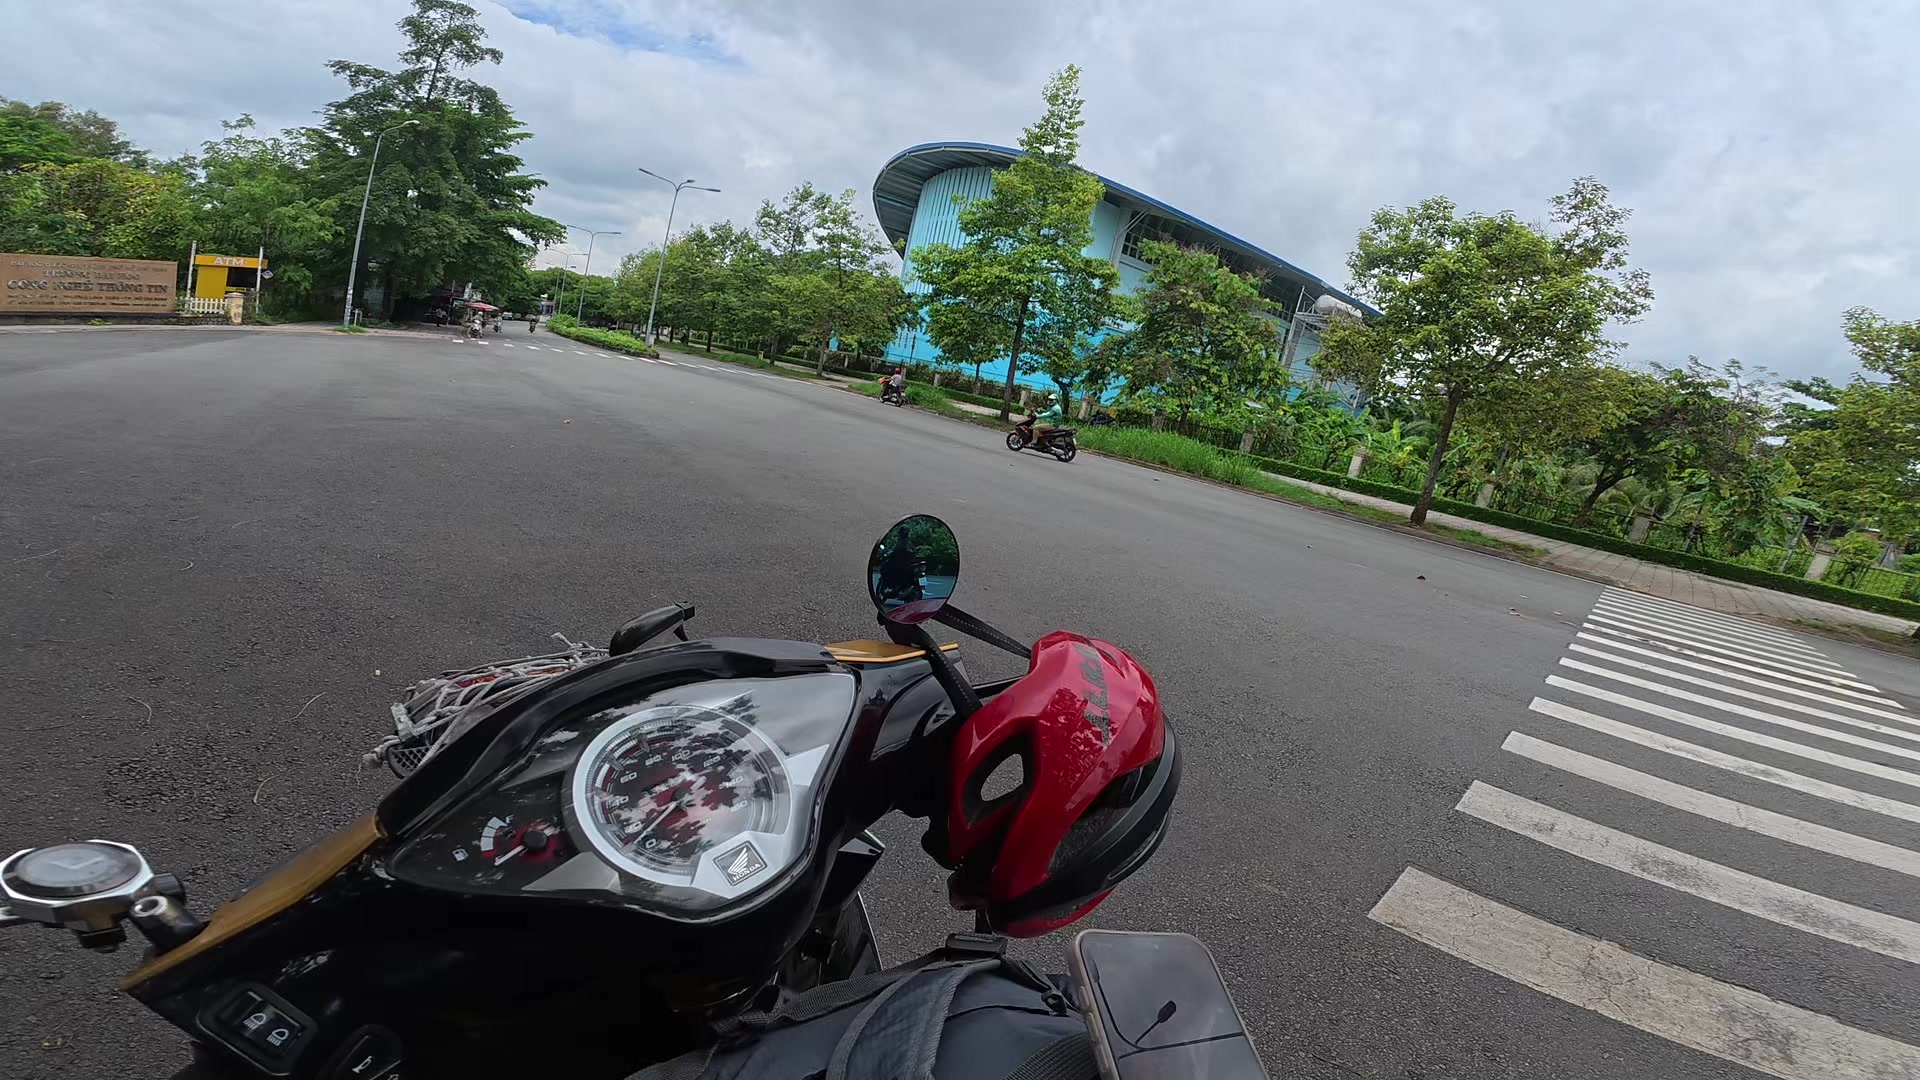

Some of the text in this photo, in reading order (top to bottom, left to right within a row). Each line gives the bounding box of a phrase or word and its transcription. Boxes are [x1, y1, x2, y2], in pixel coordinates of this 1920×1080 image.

[215, 256, 245, 265] ATM
[146, 284, 168, 294] TIN
[645, 756, 661, 766] 80
[671, 749, 691, 762] 100
[703, 756, 721, 768] 120
[620, 773, 638, 784] 60
[611, 795, 630, 808] 40
[624, 822, 642, 834] 20
[645, 838, 657, 849] 0
[732, 863, 761, 881] HONDA
